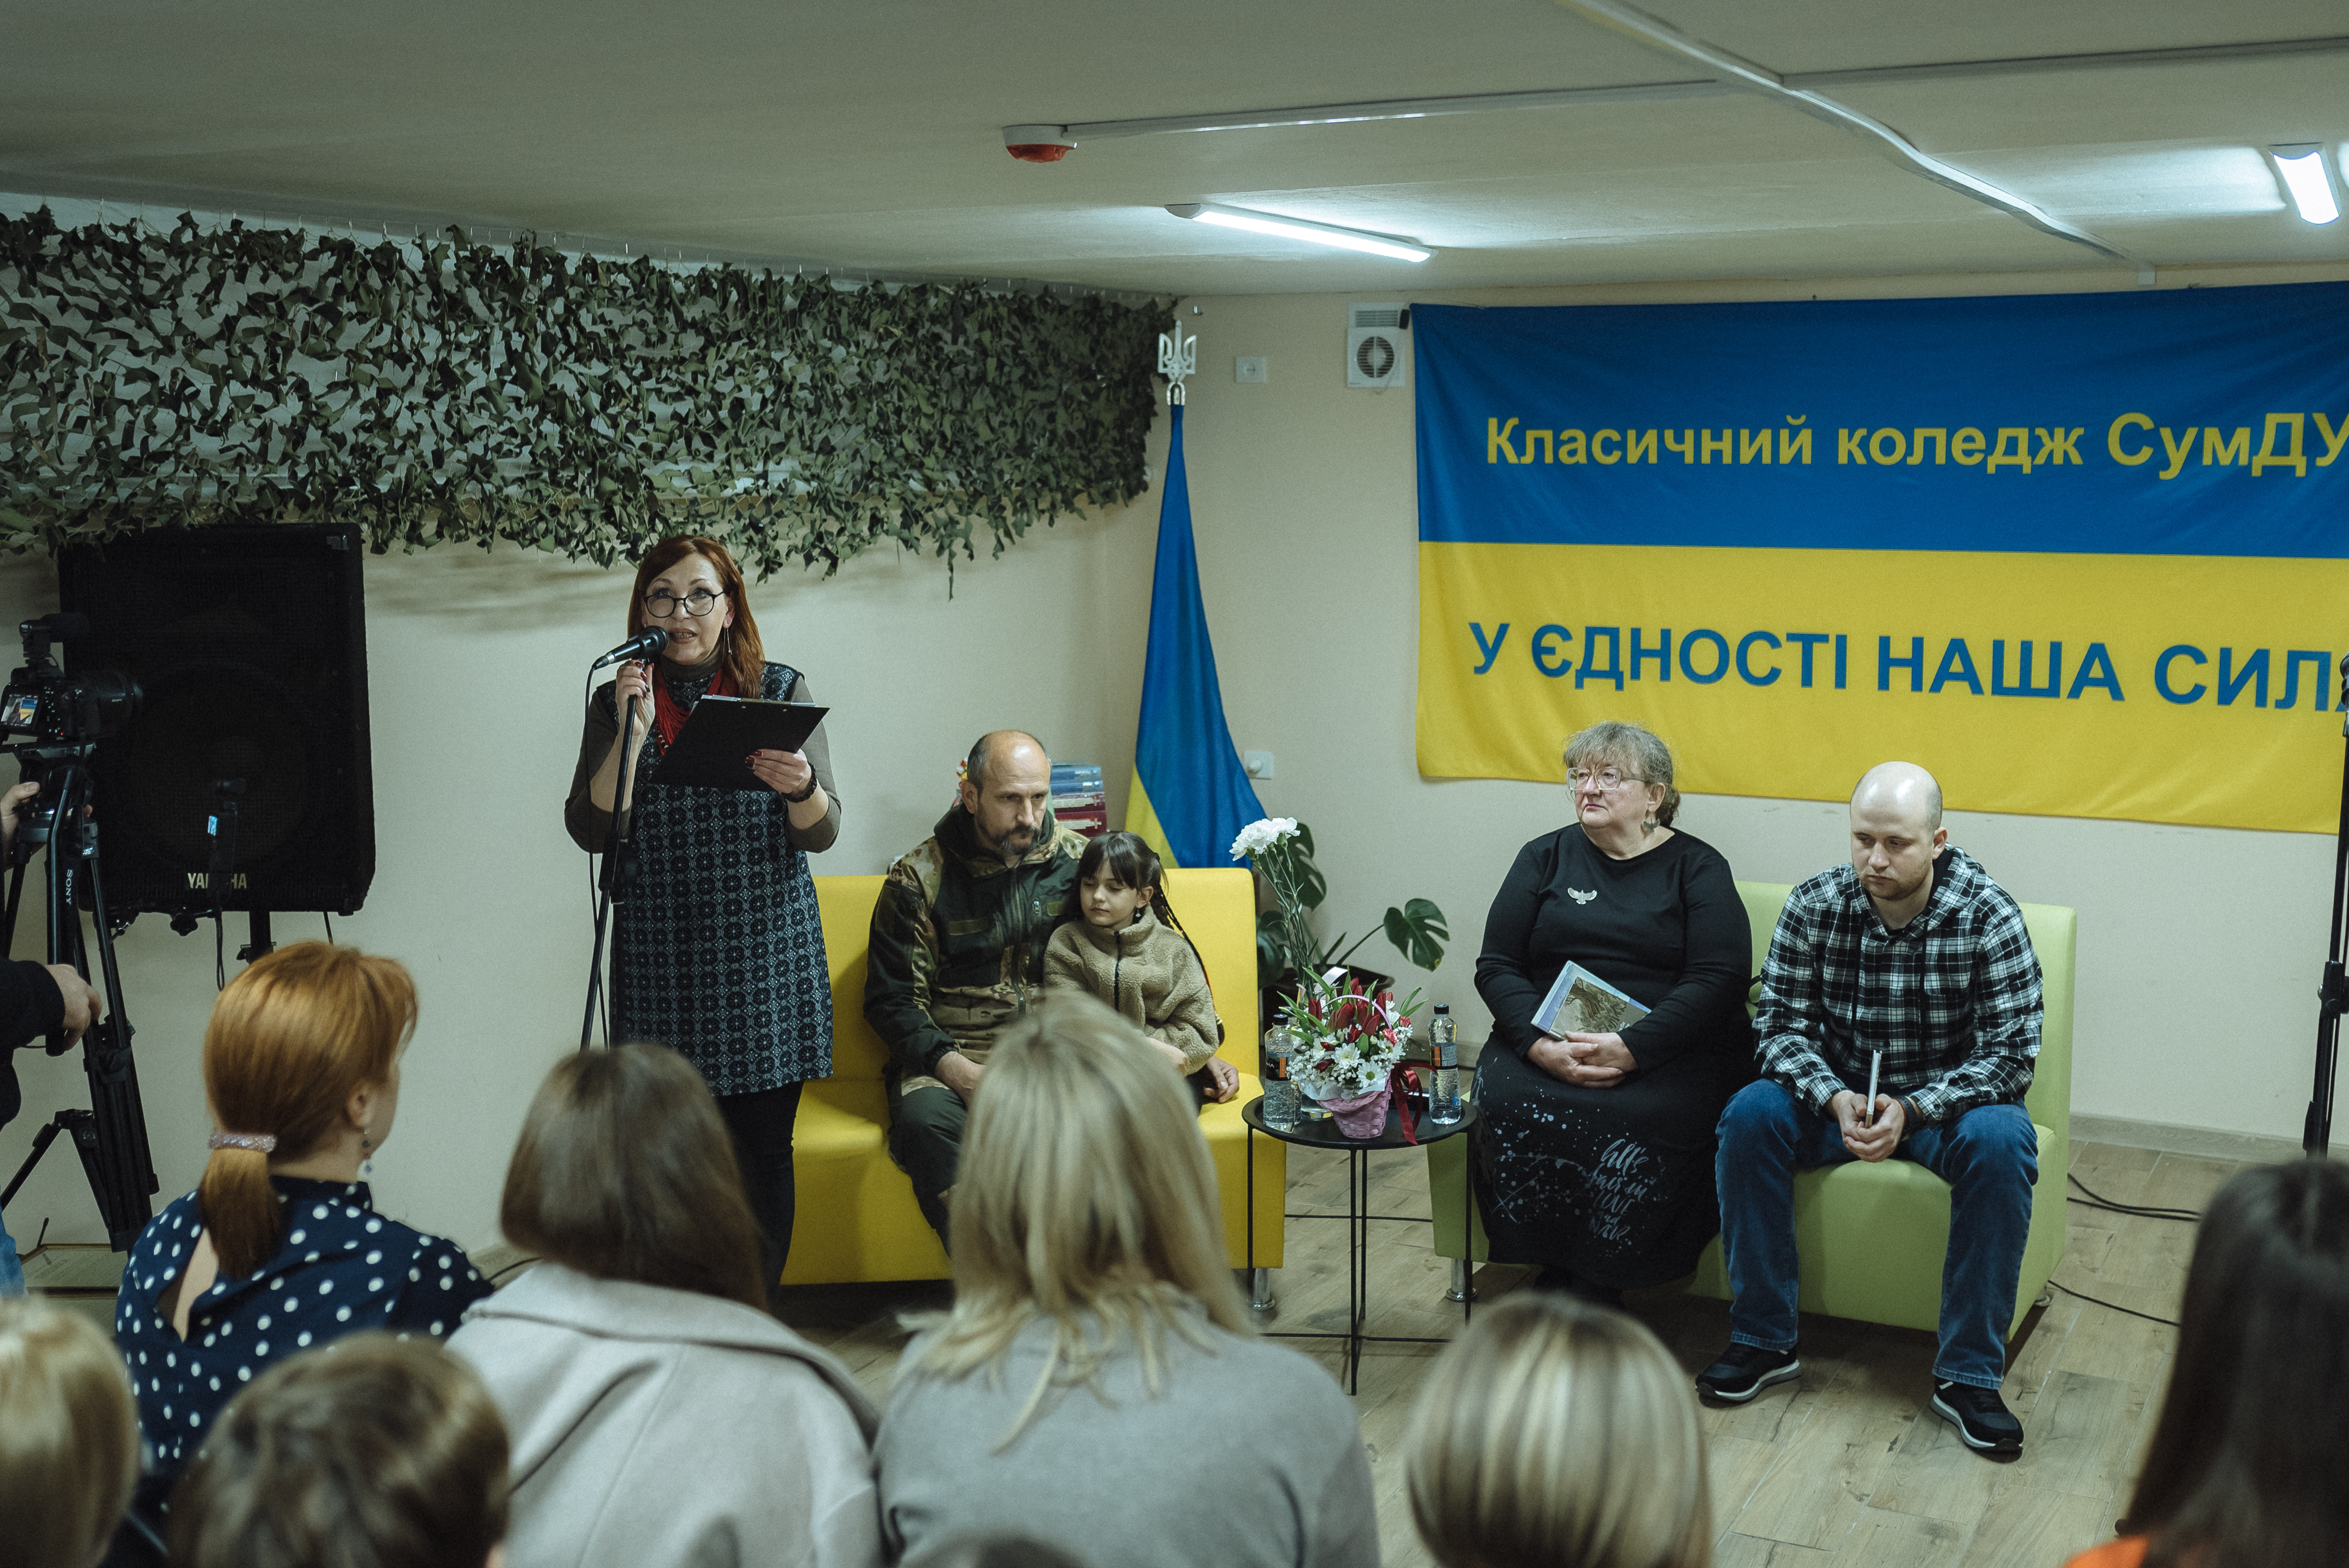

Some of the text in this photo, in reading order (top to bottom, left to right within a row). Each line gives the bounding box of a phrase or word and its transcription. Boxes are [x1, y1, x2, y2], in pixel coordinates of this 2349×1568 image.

[1486, 412, 2349, 480] Класичний коледж СумДУ
[1468, 621, 2347, 712] У ЄДНОСТІ НАША СИЛ
[187, 872, 247, 890] YAHA
